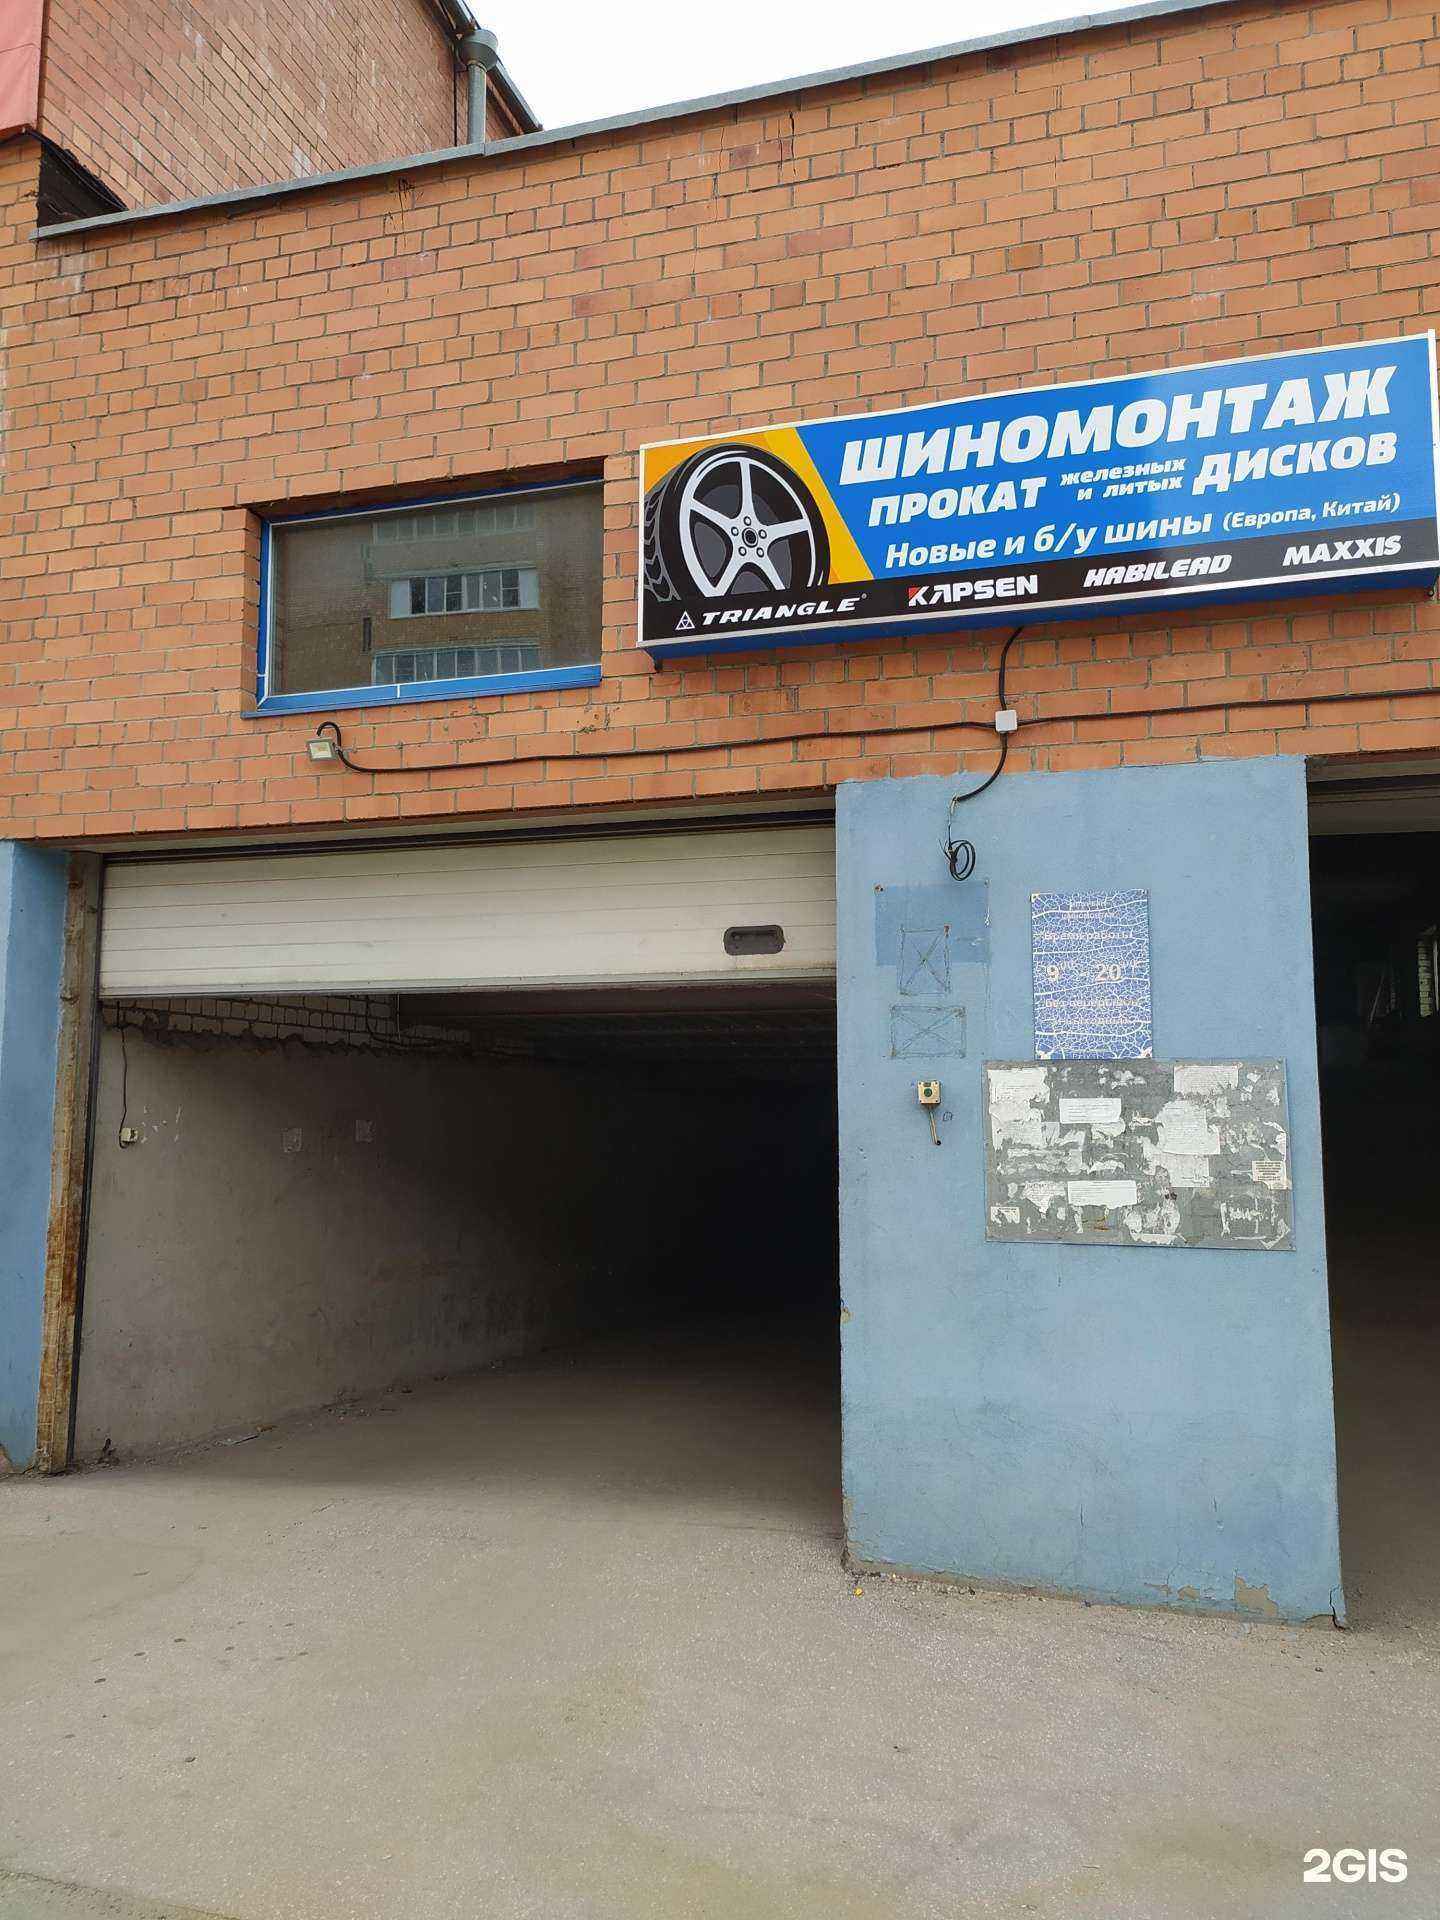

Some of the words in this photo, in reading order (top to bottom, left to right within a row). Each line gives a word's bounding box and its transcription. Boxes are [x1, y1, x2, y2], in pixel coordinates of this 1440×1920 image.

[838, 366, 1397, 485] ШИНОМОНТАЖ
[1060, 457, 1188, 486] железных
[1077, 487, 1093, 502] и
[1103, 475, 1183, 498] литых
[1192, 432, 1398, 495] ДИСКОВ
[868, 475, 1048, 527] ПРОКАТ
[885, 537, 996, 568] Новые
[1003, 535, 1025, 556] и
[1033, 522, 1098, 554] б/у
[1104, 512, 1213, 544] шины
[1222, 507, 1317, 532] (Европа,
[1322, 492, 1401, 518] Китай)
[702, 596, 861, 626] TRIANGLE
[908, 575, 1038, 606] KAPSEN
[1083, 554, 1232, 588] HABILEAD
[1282, 534, 1402, 566] MAXXIS
